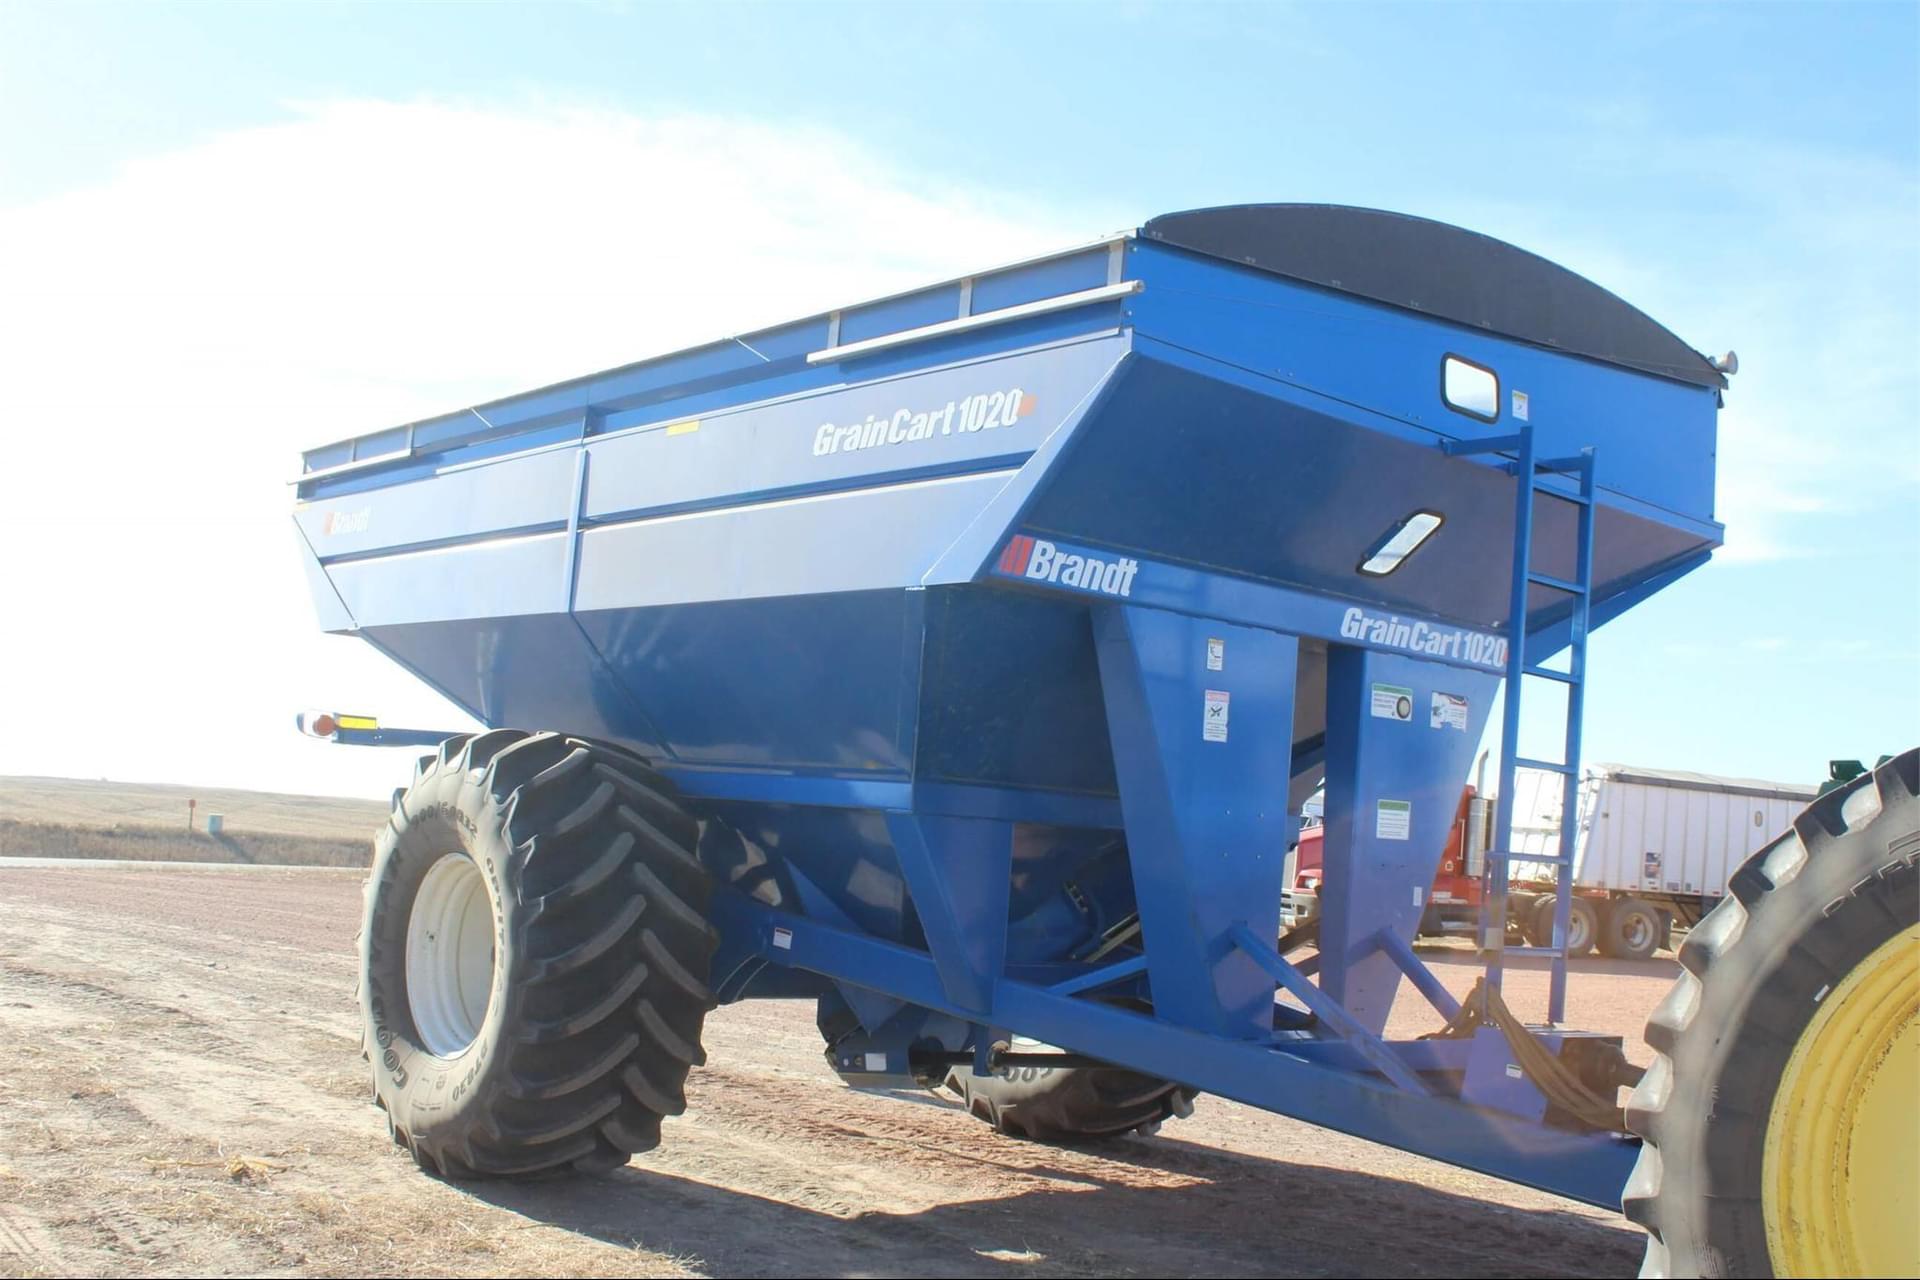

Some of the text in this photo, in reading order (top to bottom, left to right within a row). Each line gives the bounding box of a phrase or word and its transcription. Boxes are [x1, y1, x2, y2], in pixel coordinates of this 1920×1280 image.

[813, 388, 1024, 457] GrainCart 1020
[1026, 540, 1138, 597] Brandt
[1340, 607, 1508, 668] GrainCart 1020
